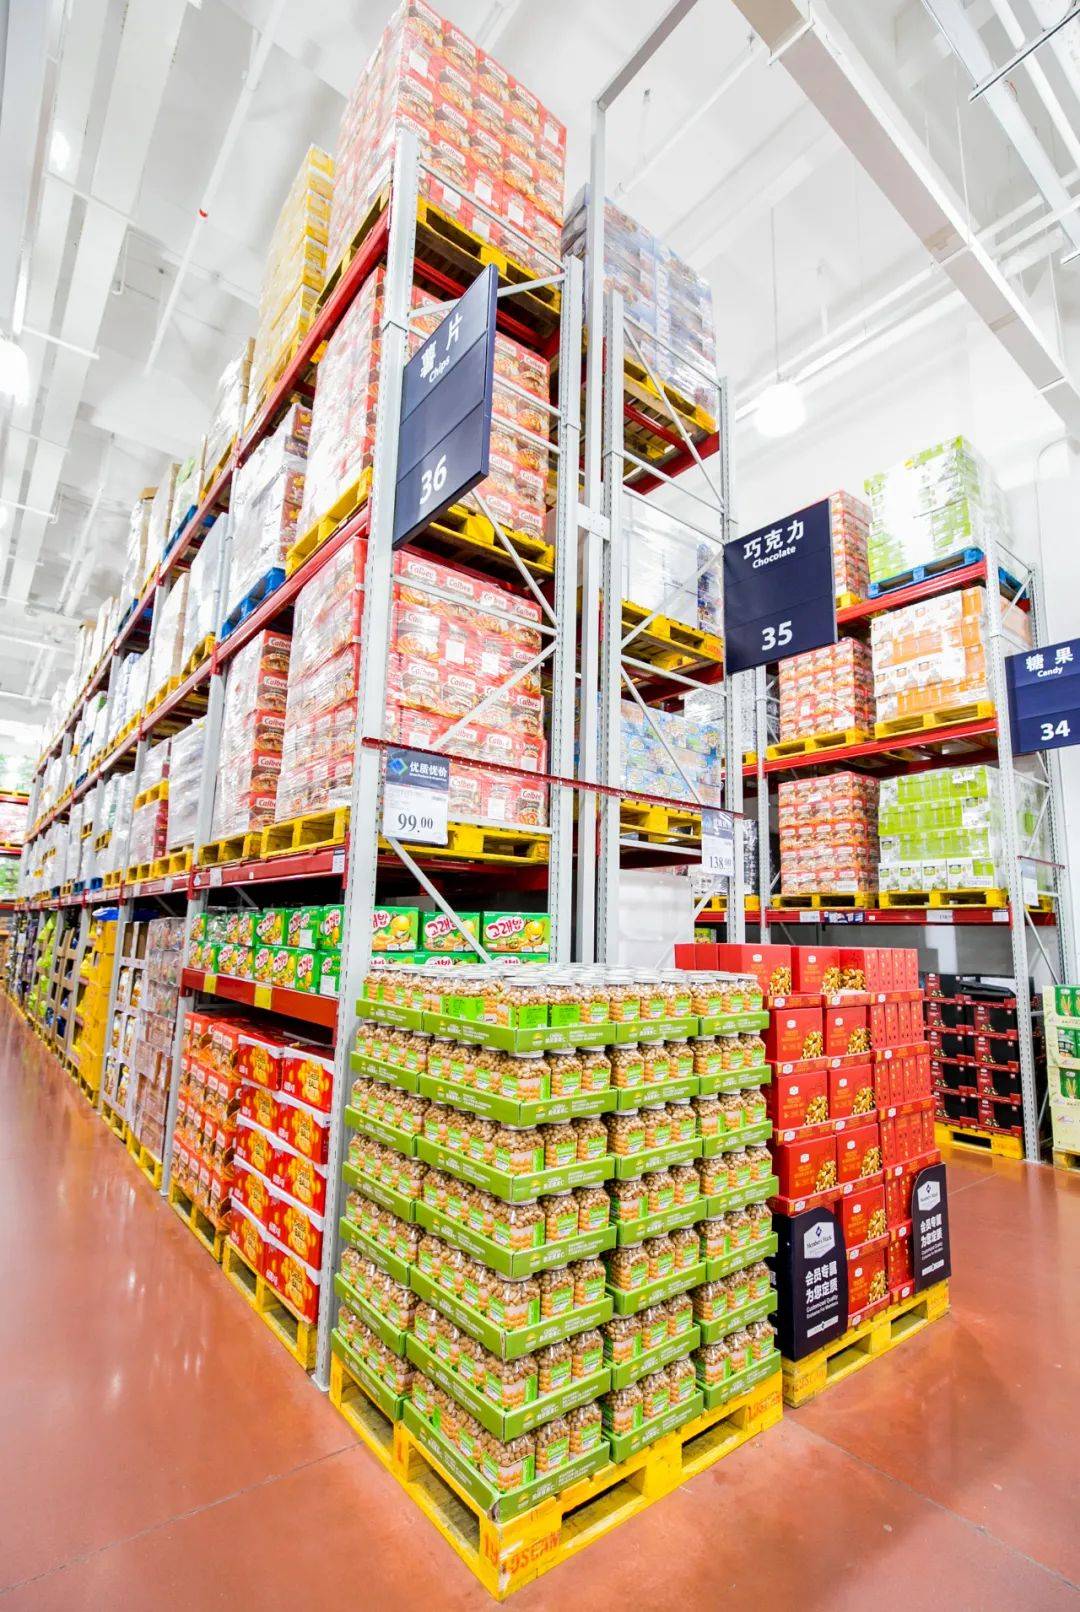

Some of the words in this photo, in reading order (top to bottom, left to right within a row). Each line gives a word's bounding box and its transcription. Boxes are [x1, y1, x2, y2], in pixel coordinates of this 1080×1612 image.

[419, 454, 448, 506] 36
[743, 519, 804, 560] 巧克力
[752, 545, 797, 569] Chocolate
[761, 620, 793, 651] 35
[1037, 666, 1063, 678] Candy
[1040, 719, 1071, 742] 34
[409, 760, 448, 778] 优质优价
[522, 790, 542, 800] Calbee
[397, 812, 434, 833] 99.00
[488, 917, 522, 938] 고래밥
